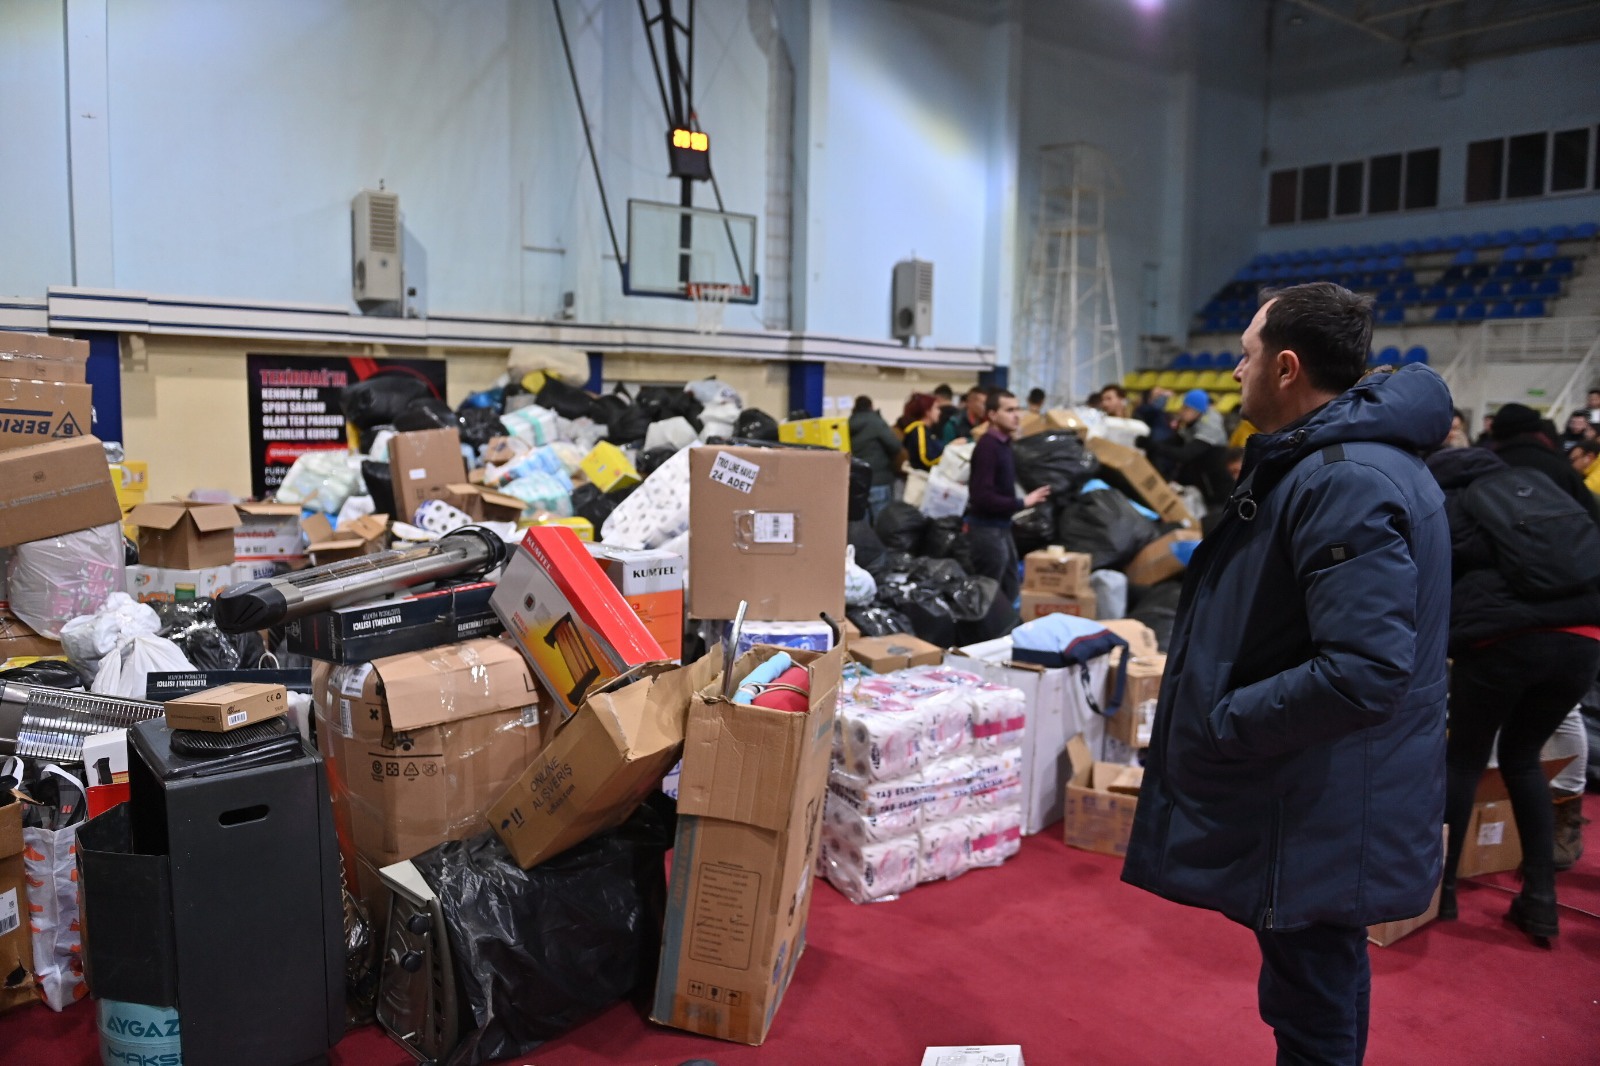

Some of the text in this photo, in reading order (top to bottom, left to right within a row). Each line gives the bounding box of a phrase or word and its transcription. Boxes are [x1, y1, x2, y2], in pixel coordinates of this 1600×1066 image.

[261, 401, 326, 414] SPOR SALONU
[0, 419, 51, 435] BERI
[262, 415, 345, 427] OLAN TEK PARKUR
[262, 428, 339, 440] HAZIRLIK KURSU
[711, 470, 752, 492] 24 ADET
[525, 536, 553, 573] KUMTEL
[632, 566, 677, 578] KUMTEL
[530, 755, 560, 792] ONLINE
[106, 1015, 180, 1038] AYGAZ
